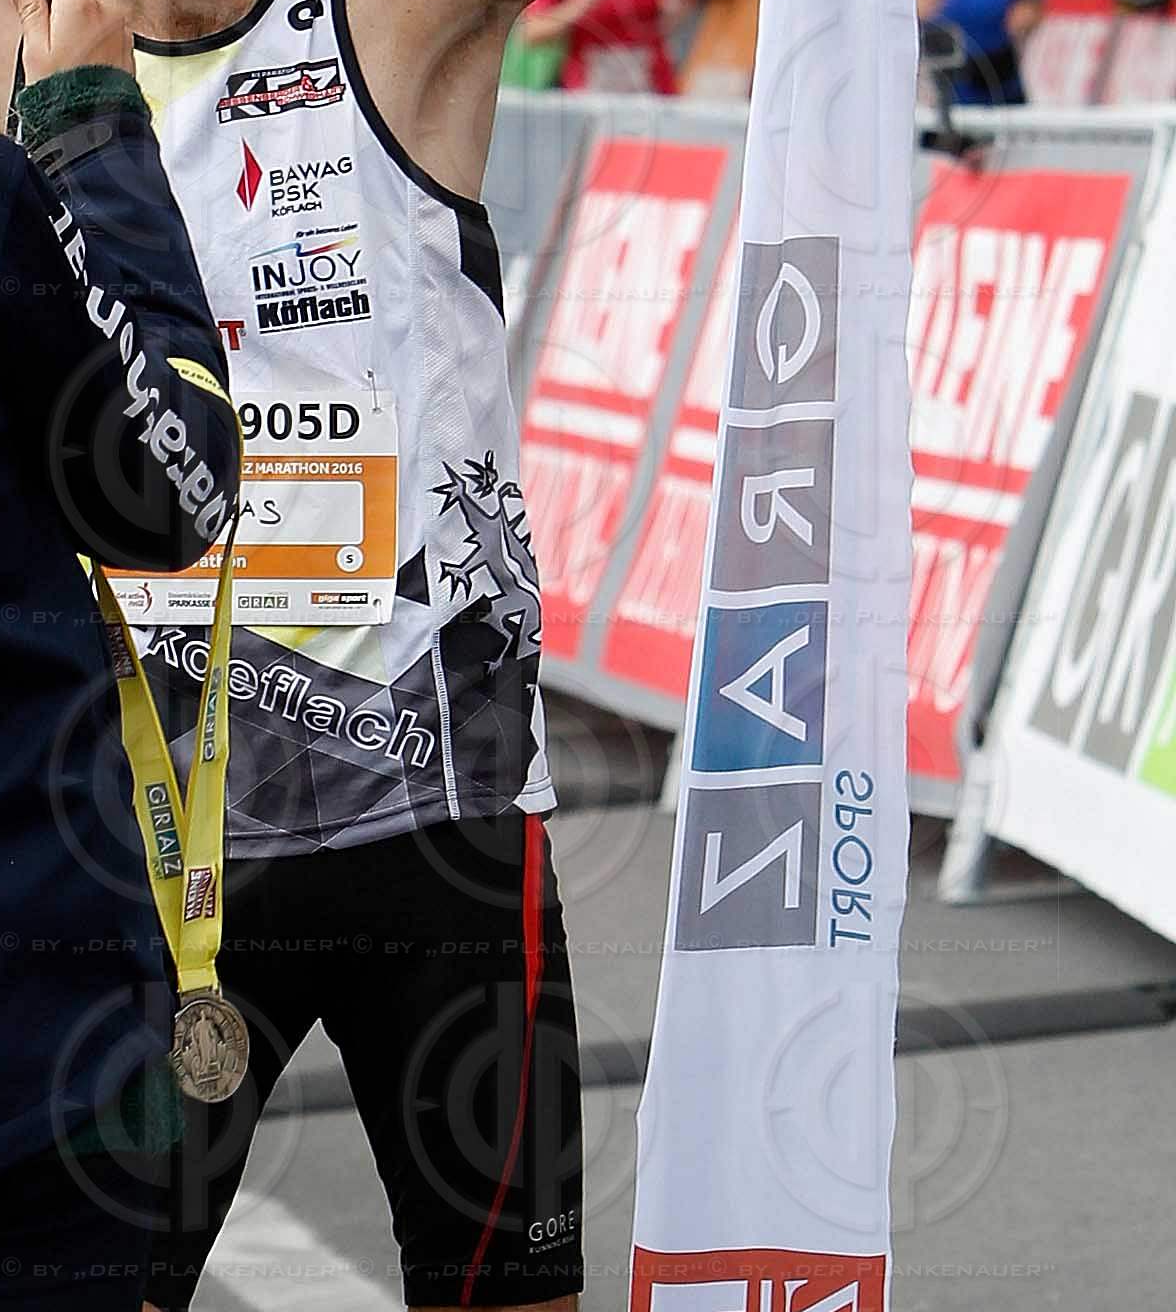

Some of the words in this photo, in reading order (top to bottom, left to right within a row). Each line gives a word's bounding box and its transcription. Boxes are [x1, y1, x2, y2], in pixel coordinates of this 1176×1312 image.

[270, 156, 352, 186] BAWAG
[271, 182, 320, 205] PSK
[252, 249, 361, 292] INJOY
[257, 289, 370, 330] Köflach
[255, 462, 330, 475] MARATHON
[331, 462, 363, 474] 2016
[167, 599, 211, 608] SPARKASSE
[238, 596, 289, 609] GRAZ
[148, 786, 183, 876] GRAZ
[529, 1210, 575, 1241] GORE
